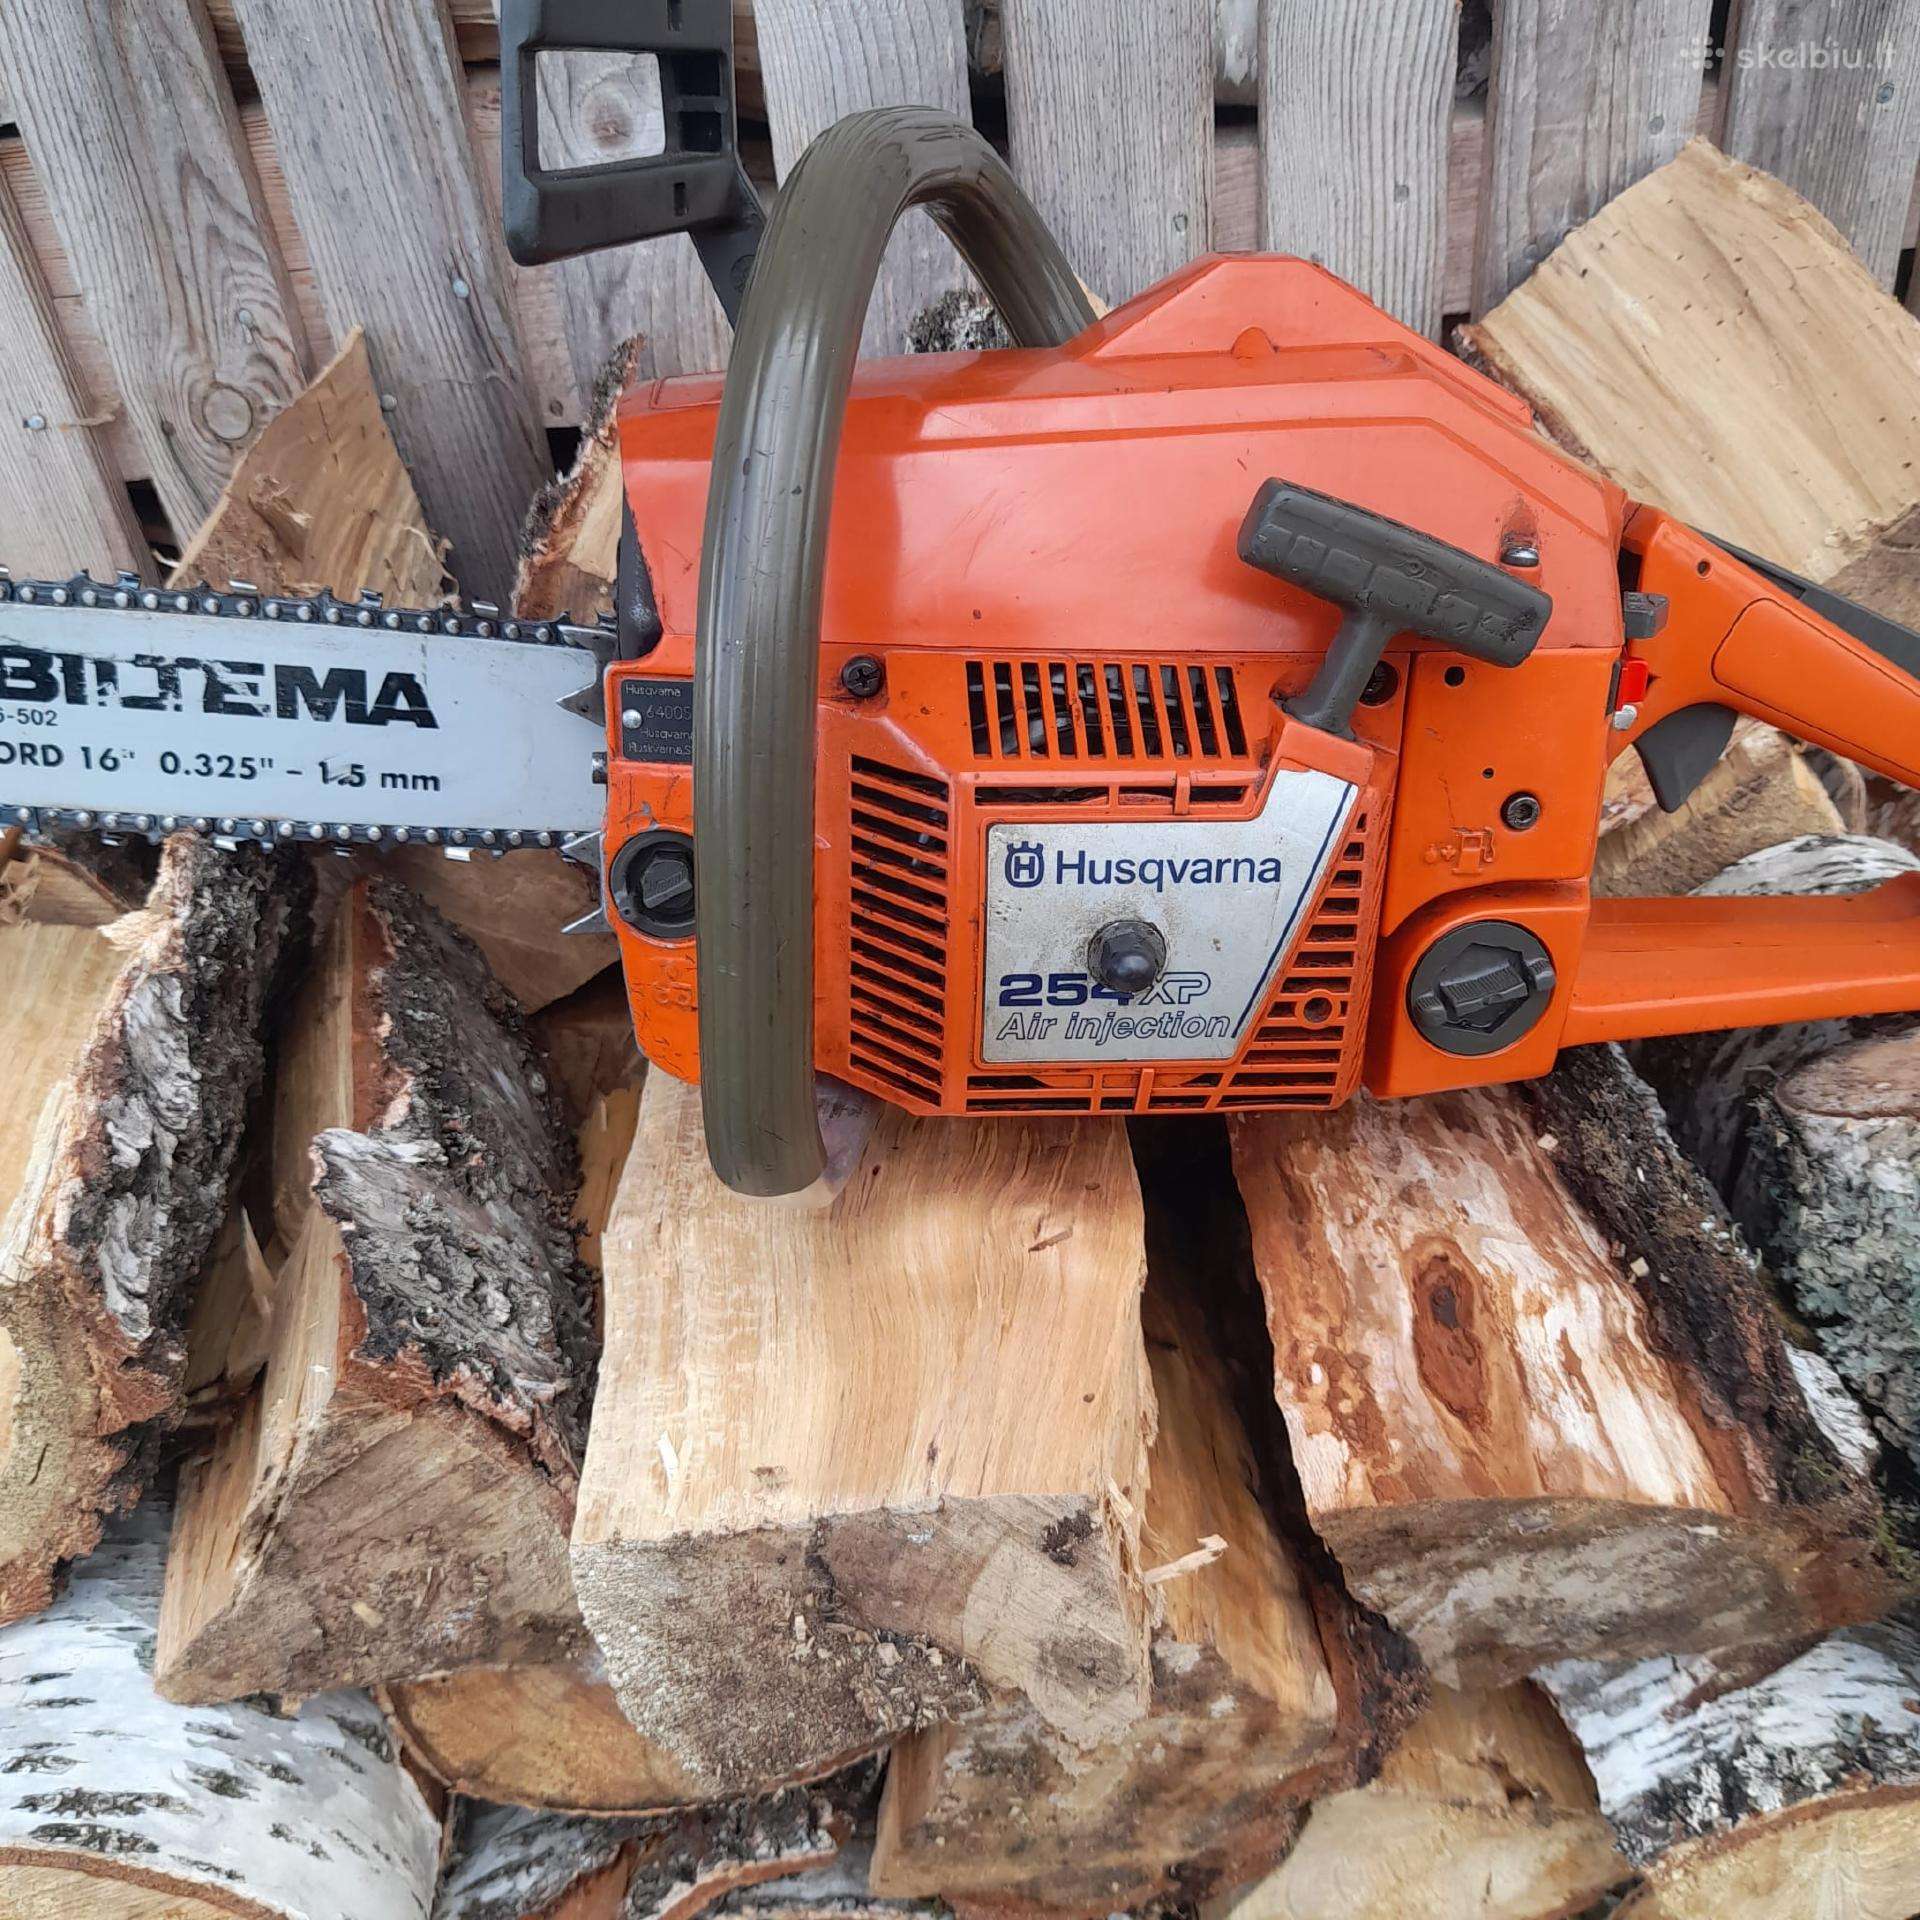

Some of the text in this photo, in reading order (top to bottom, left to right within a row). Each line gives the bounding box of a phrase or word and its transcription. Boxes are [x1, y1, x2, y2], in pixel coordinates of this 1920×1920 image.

[160, 751, 273, 780] 0.325"
[380, 771, 441, 792] mm
[1056, 850, 1282, 892] Husqvarna
[996, 1010, 1231, 1046] Air injection
